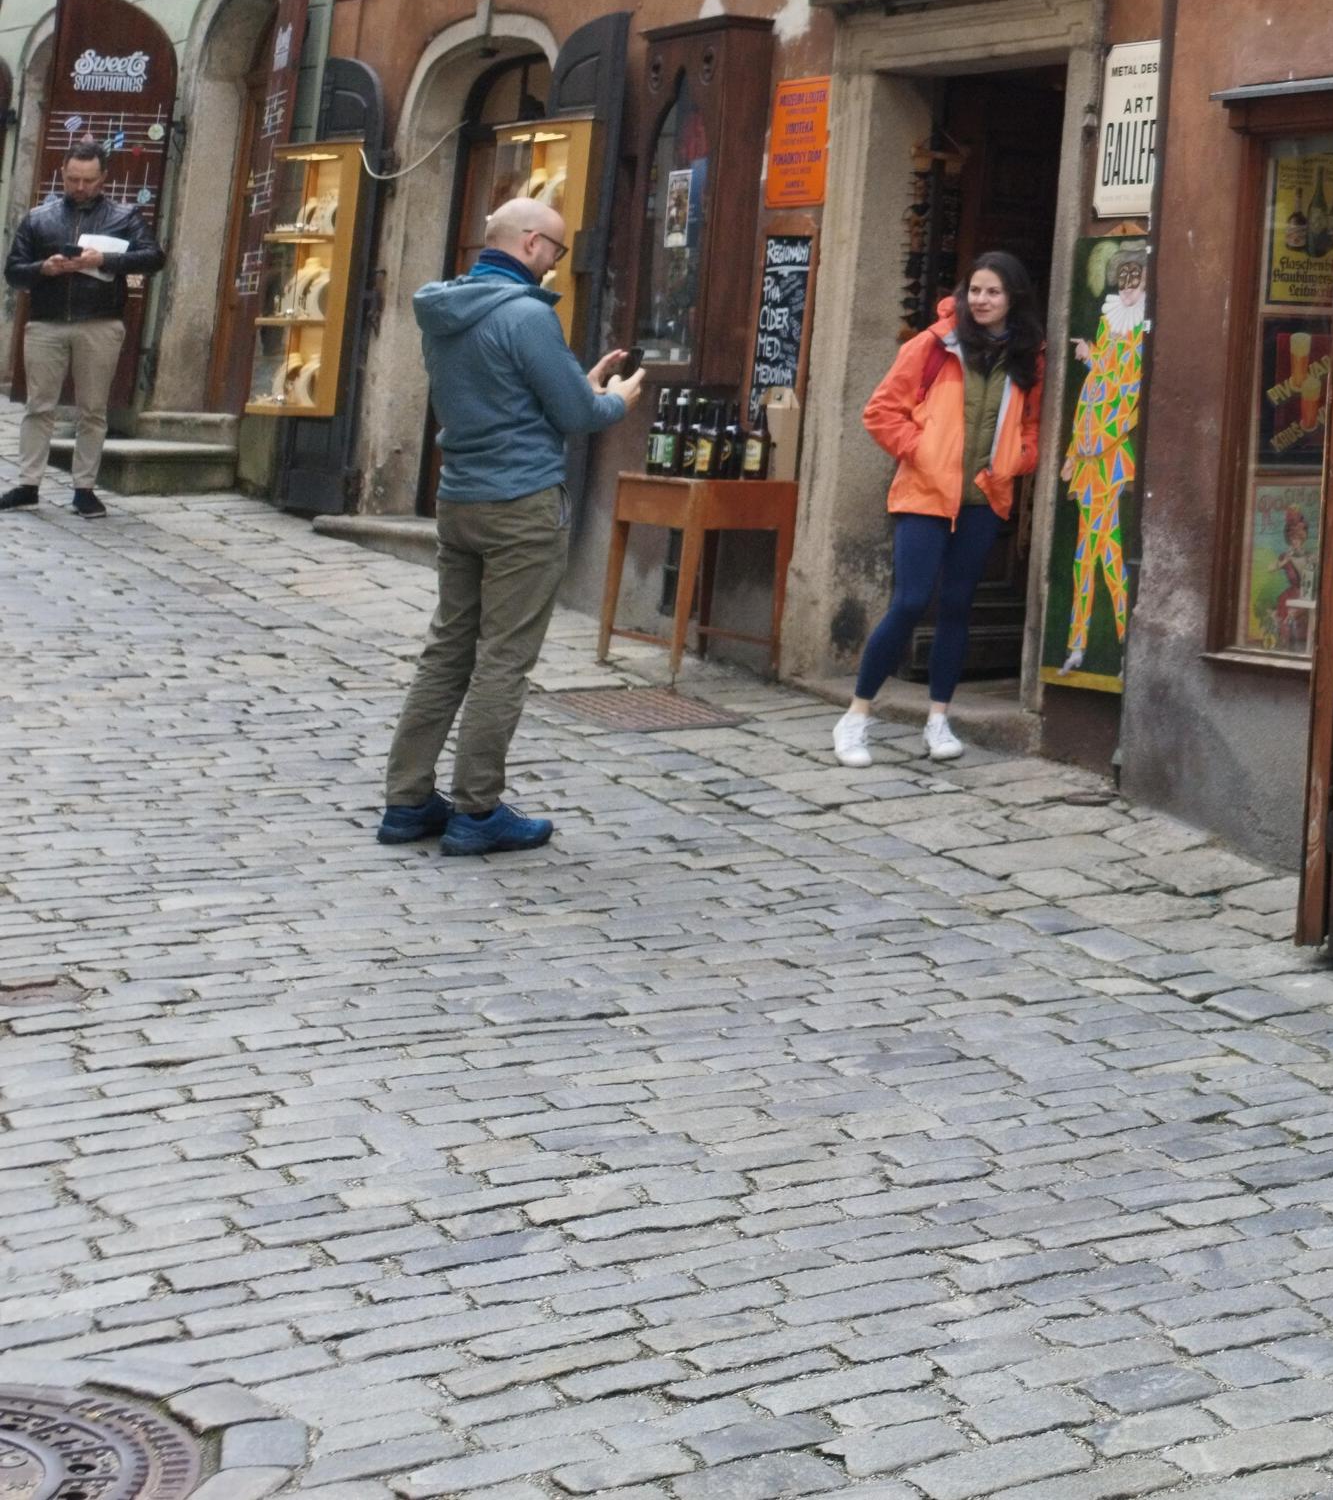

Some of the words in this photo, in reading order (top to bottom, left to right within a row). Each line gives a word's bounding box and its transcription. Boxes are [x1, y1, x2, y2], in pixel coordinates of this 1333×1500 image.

[1111, 64, 1139, 77] METAL
[1140, 62, 1160, 75] DES
[1123, 96, 1153, 114] ART
[756, 332, 782, 361] MED
